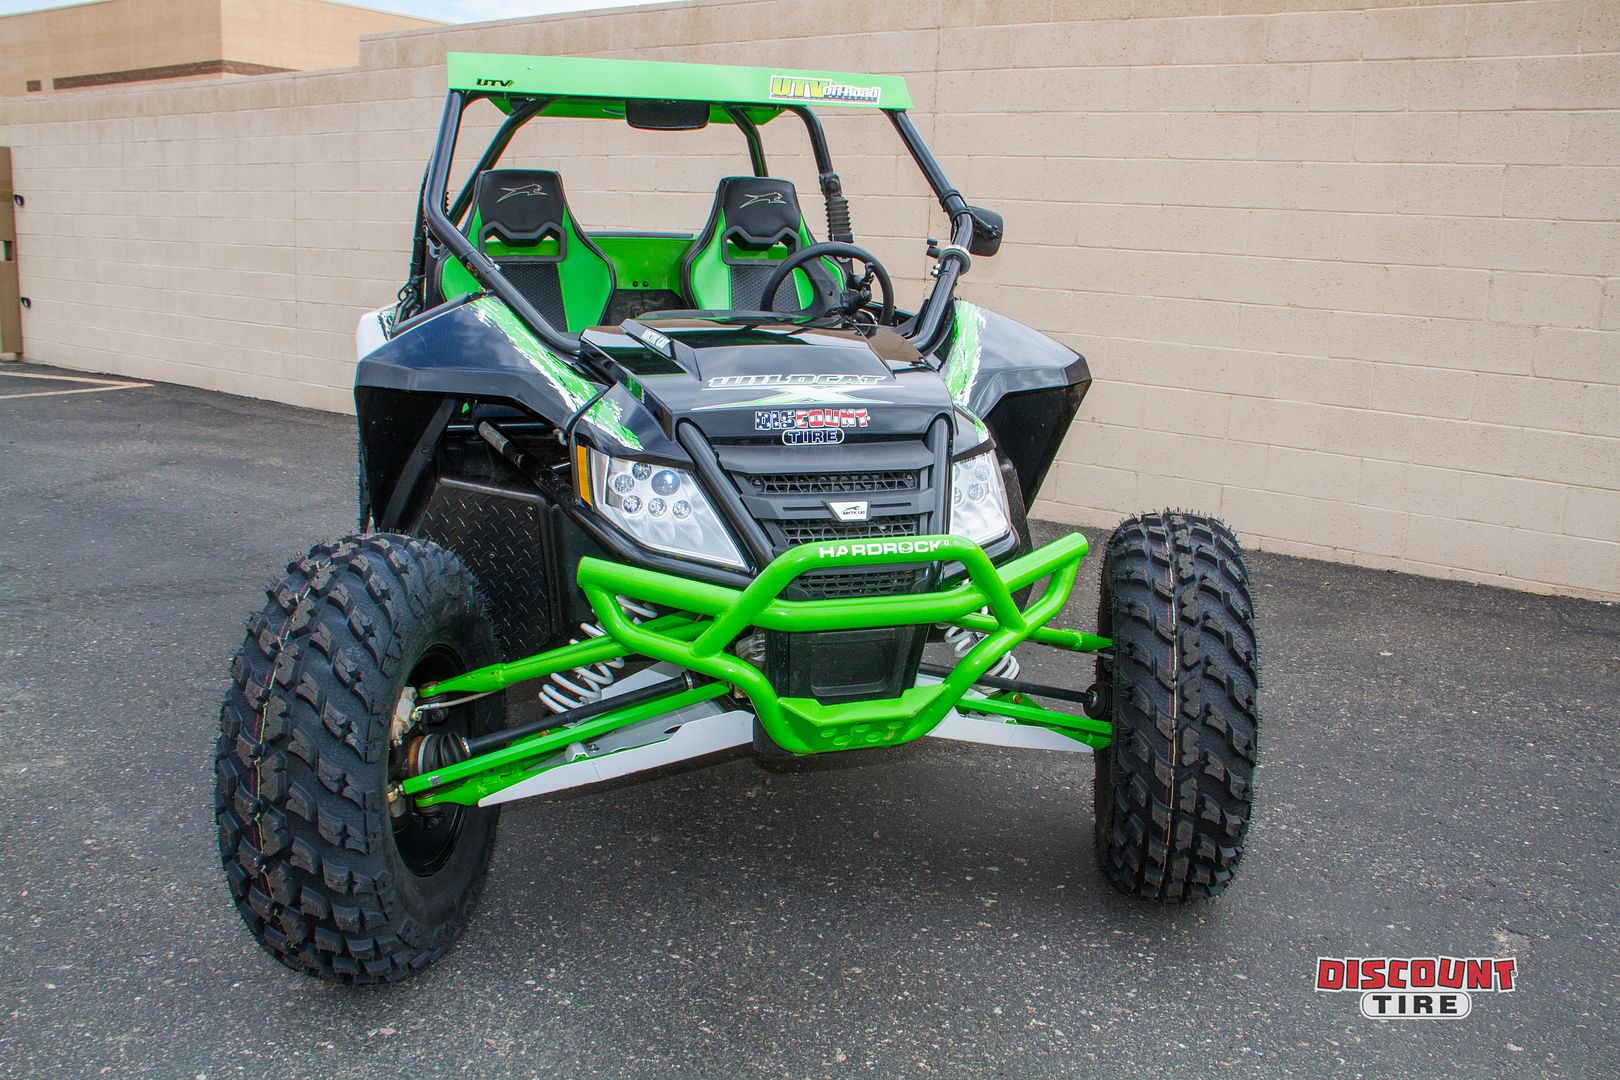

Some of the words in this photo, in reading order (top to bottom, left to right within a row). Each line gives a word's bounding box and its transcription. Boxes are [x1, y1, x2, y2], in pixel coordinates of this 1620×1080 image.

[770, 76, 830, 98] UTV
[707, 374, 888, 388] WILDCAT
[754, 408, 869, 431] DISCOUNT
[788, 430, 839, 444] TIRE
[818, 540, 942, 559] HARDROCK
